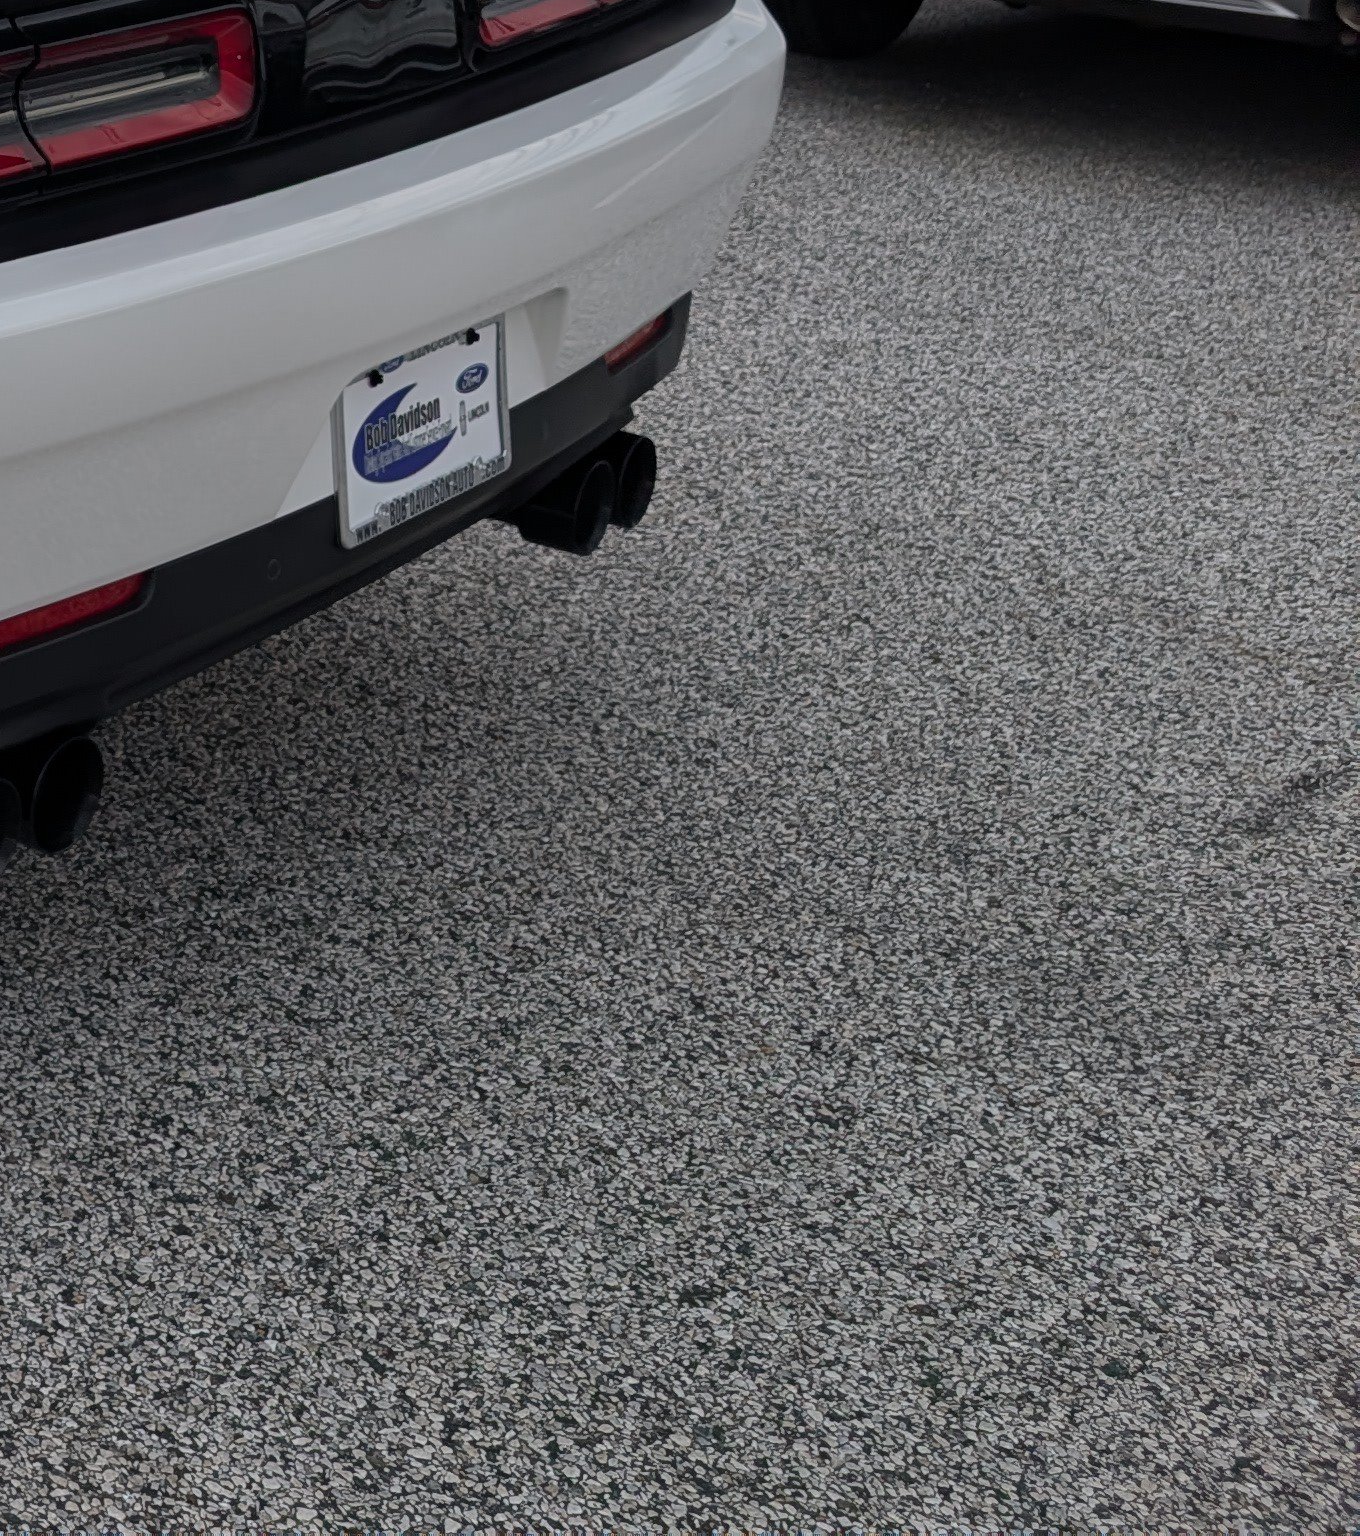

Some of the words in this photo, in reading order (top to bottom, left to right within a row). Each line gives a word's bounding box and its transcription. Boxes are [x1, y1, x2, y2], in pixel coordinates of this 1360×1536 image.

[364, 419, 389, 451] Bob
[389, 397, 440, 440] Davidson
[409, 477, 451, 516] DAVIDSON
[451, 464, 474, 492] AUTO
